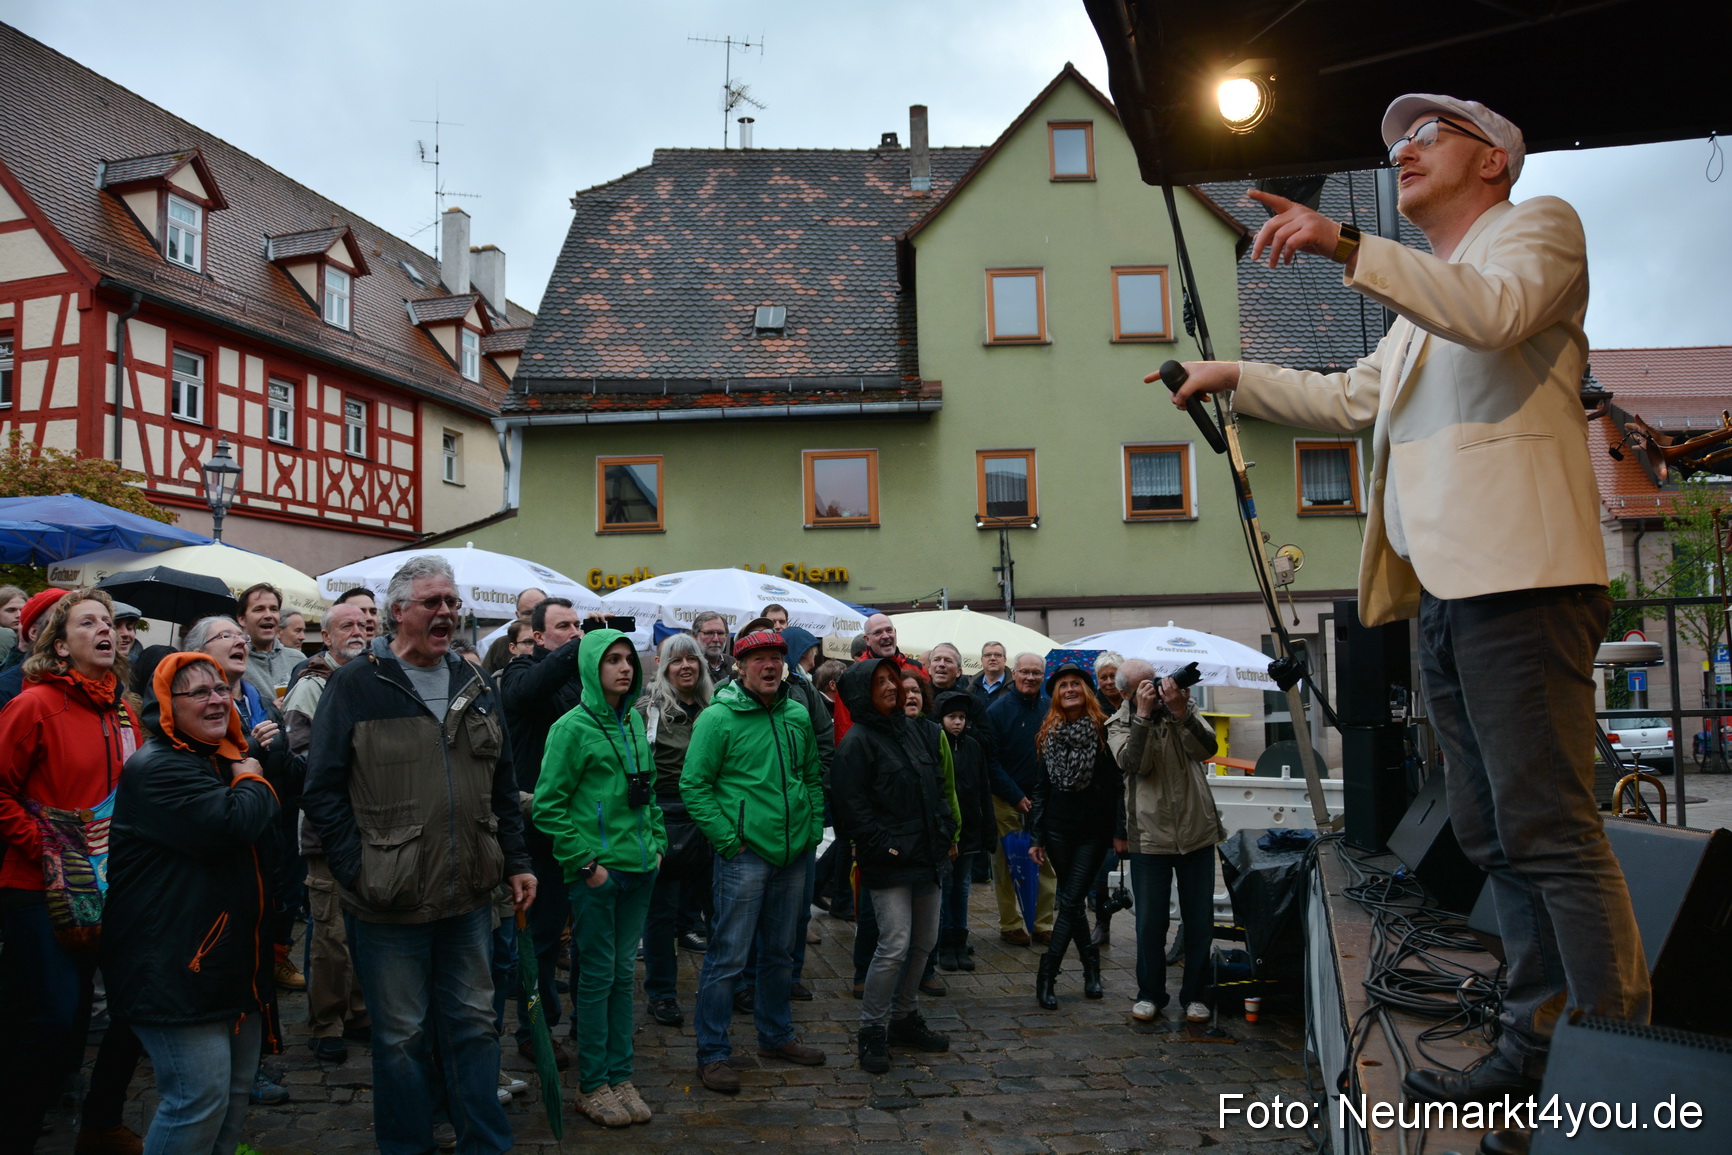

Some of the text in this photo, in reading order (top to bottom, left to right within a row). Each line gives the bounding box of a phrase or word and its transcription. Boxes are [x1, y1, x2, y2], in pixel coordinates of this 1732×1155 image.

[587, 567, 672, 590] Gasth
[781, 561, 849, 583] Stern
[470, 586, 520, 604] Gutma
[1072, 616, 1085, 627] 12
